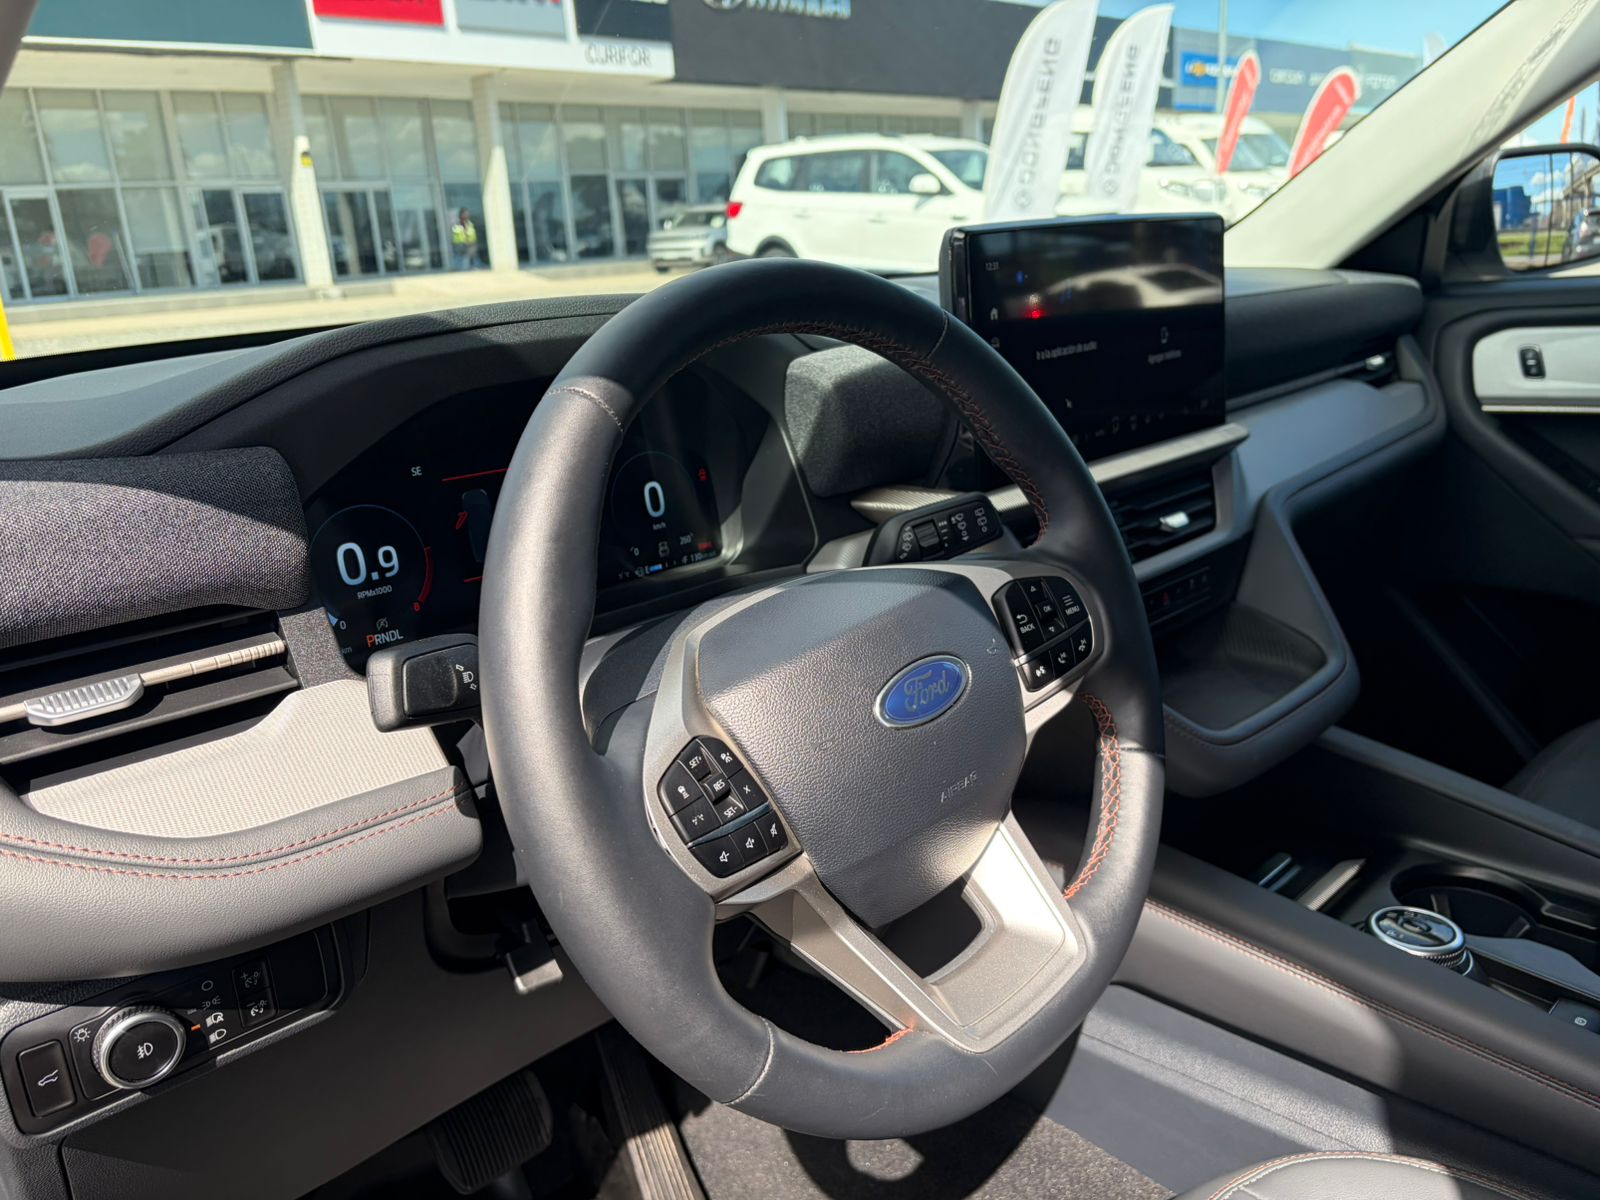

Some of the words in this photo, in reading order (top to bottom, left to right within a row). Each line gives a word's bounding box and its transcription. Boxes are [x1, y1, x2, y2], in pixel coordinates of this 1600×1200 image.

[411, 466, 422, 477] SE
[643, 481, 666, 518] 0
[336, 542, 400, 586] 0.9
[1065, 605, 1080, 616] MENU
[339, 620, 347, 630] 0
[1019, 623, 1036, 634] BACK
[903, 669, 950, 713] Ford
[712, 779, 727, 792] RES
